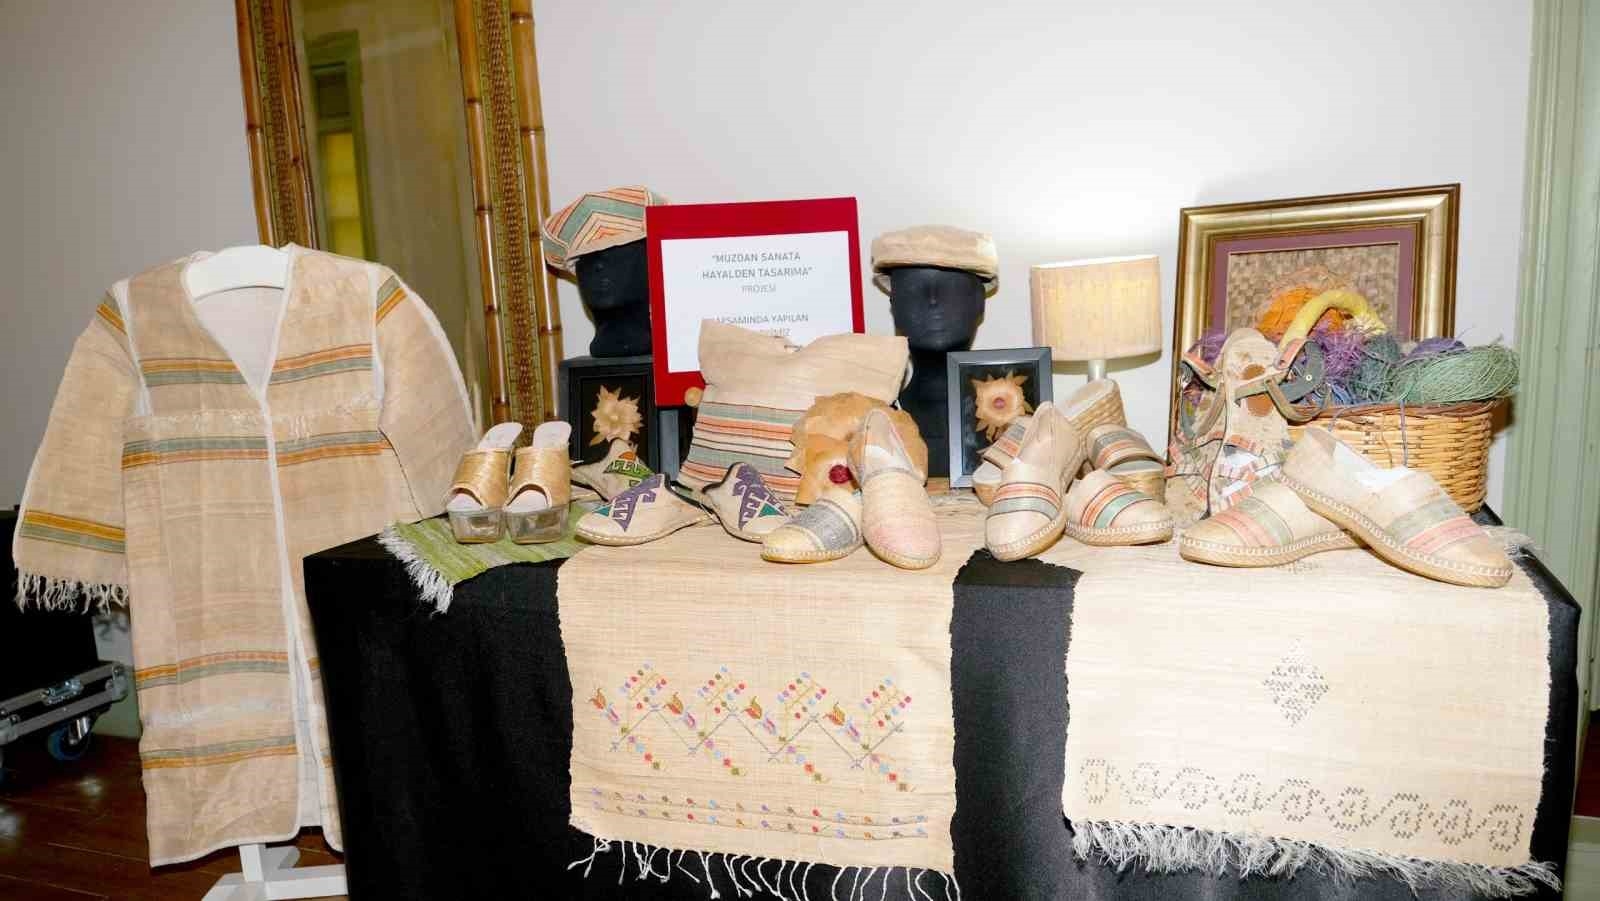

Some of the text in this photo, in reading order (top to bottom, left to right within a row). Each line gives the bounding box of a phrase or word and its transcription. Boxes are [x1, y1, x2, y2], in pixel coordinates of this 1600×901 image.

[761, 252, 801, 262] SANATA
[702, 269, 755, 280] HAYALDEN
[771, 314, 808, 323] YAPILAN
